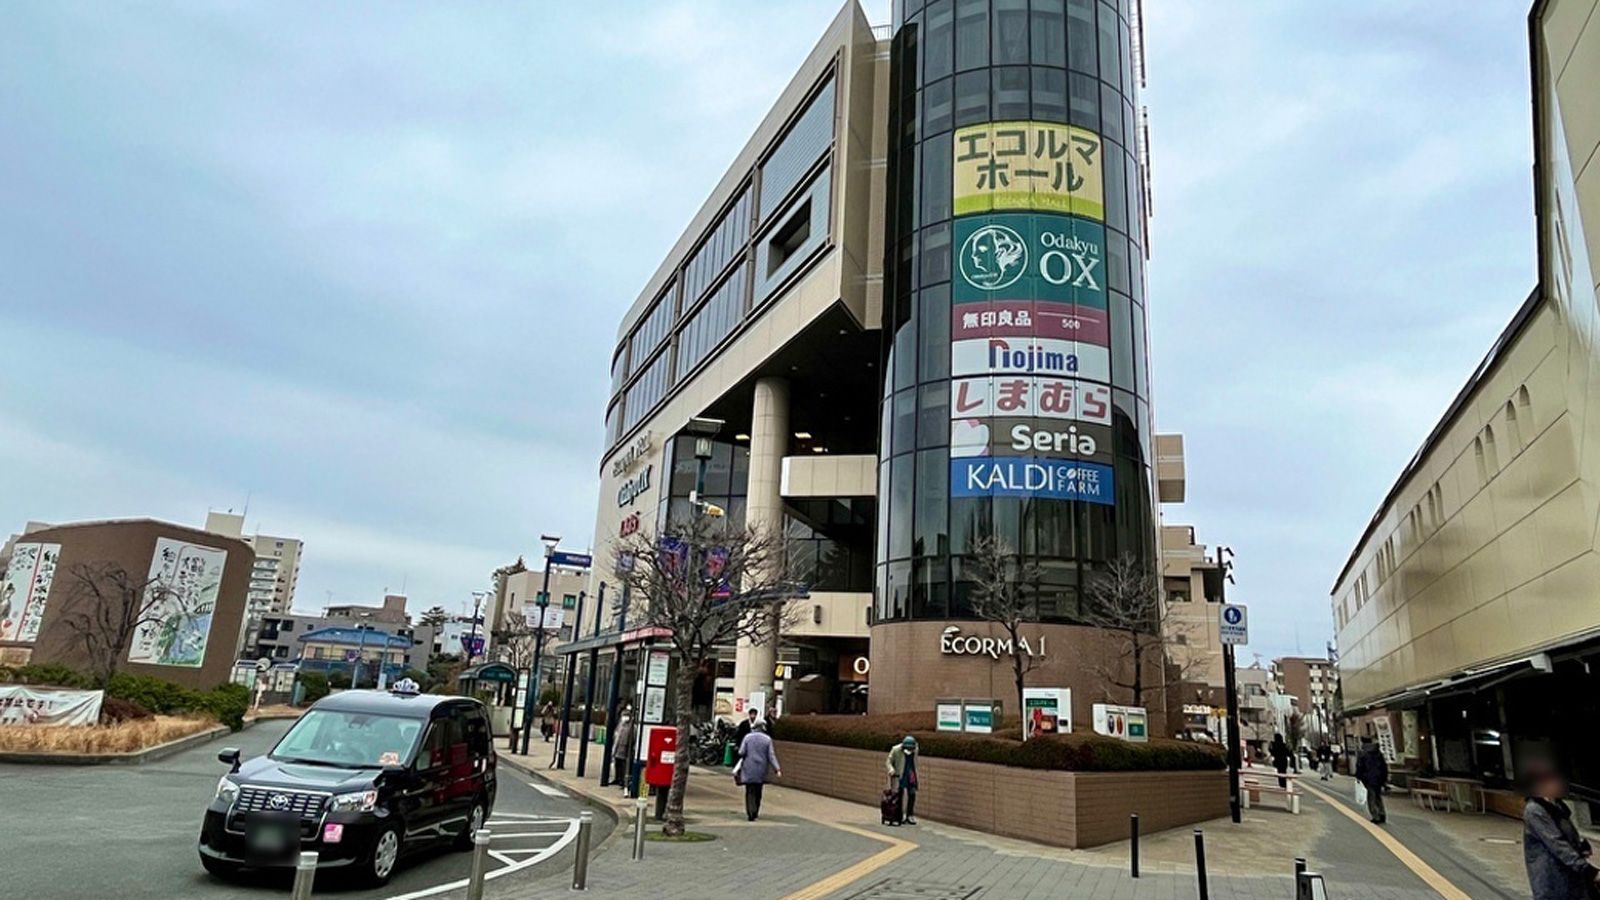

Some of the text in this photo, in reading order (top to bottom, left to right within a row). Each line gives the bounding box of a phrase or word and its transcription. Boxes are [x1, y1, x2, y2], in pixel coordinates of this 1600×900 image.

[957, 129, 1099, 166] エコルマ
[976, 159, 1084, 192] ホール
[1040, 231, 1099, 255] Odakyu
[1039, 250, 1100, 291] OX
[962, 309, 1032, 329] 無印良品
[956, 379, 1108, 419] しまむら
[1011, 424, 1097, 456] Seria
[967, 463, 1099, 492] KALDI COFFEE
[1057, 480, 1100, 496] FARM
[940, 630, 1033, 659] ECORMA
